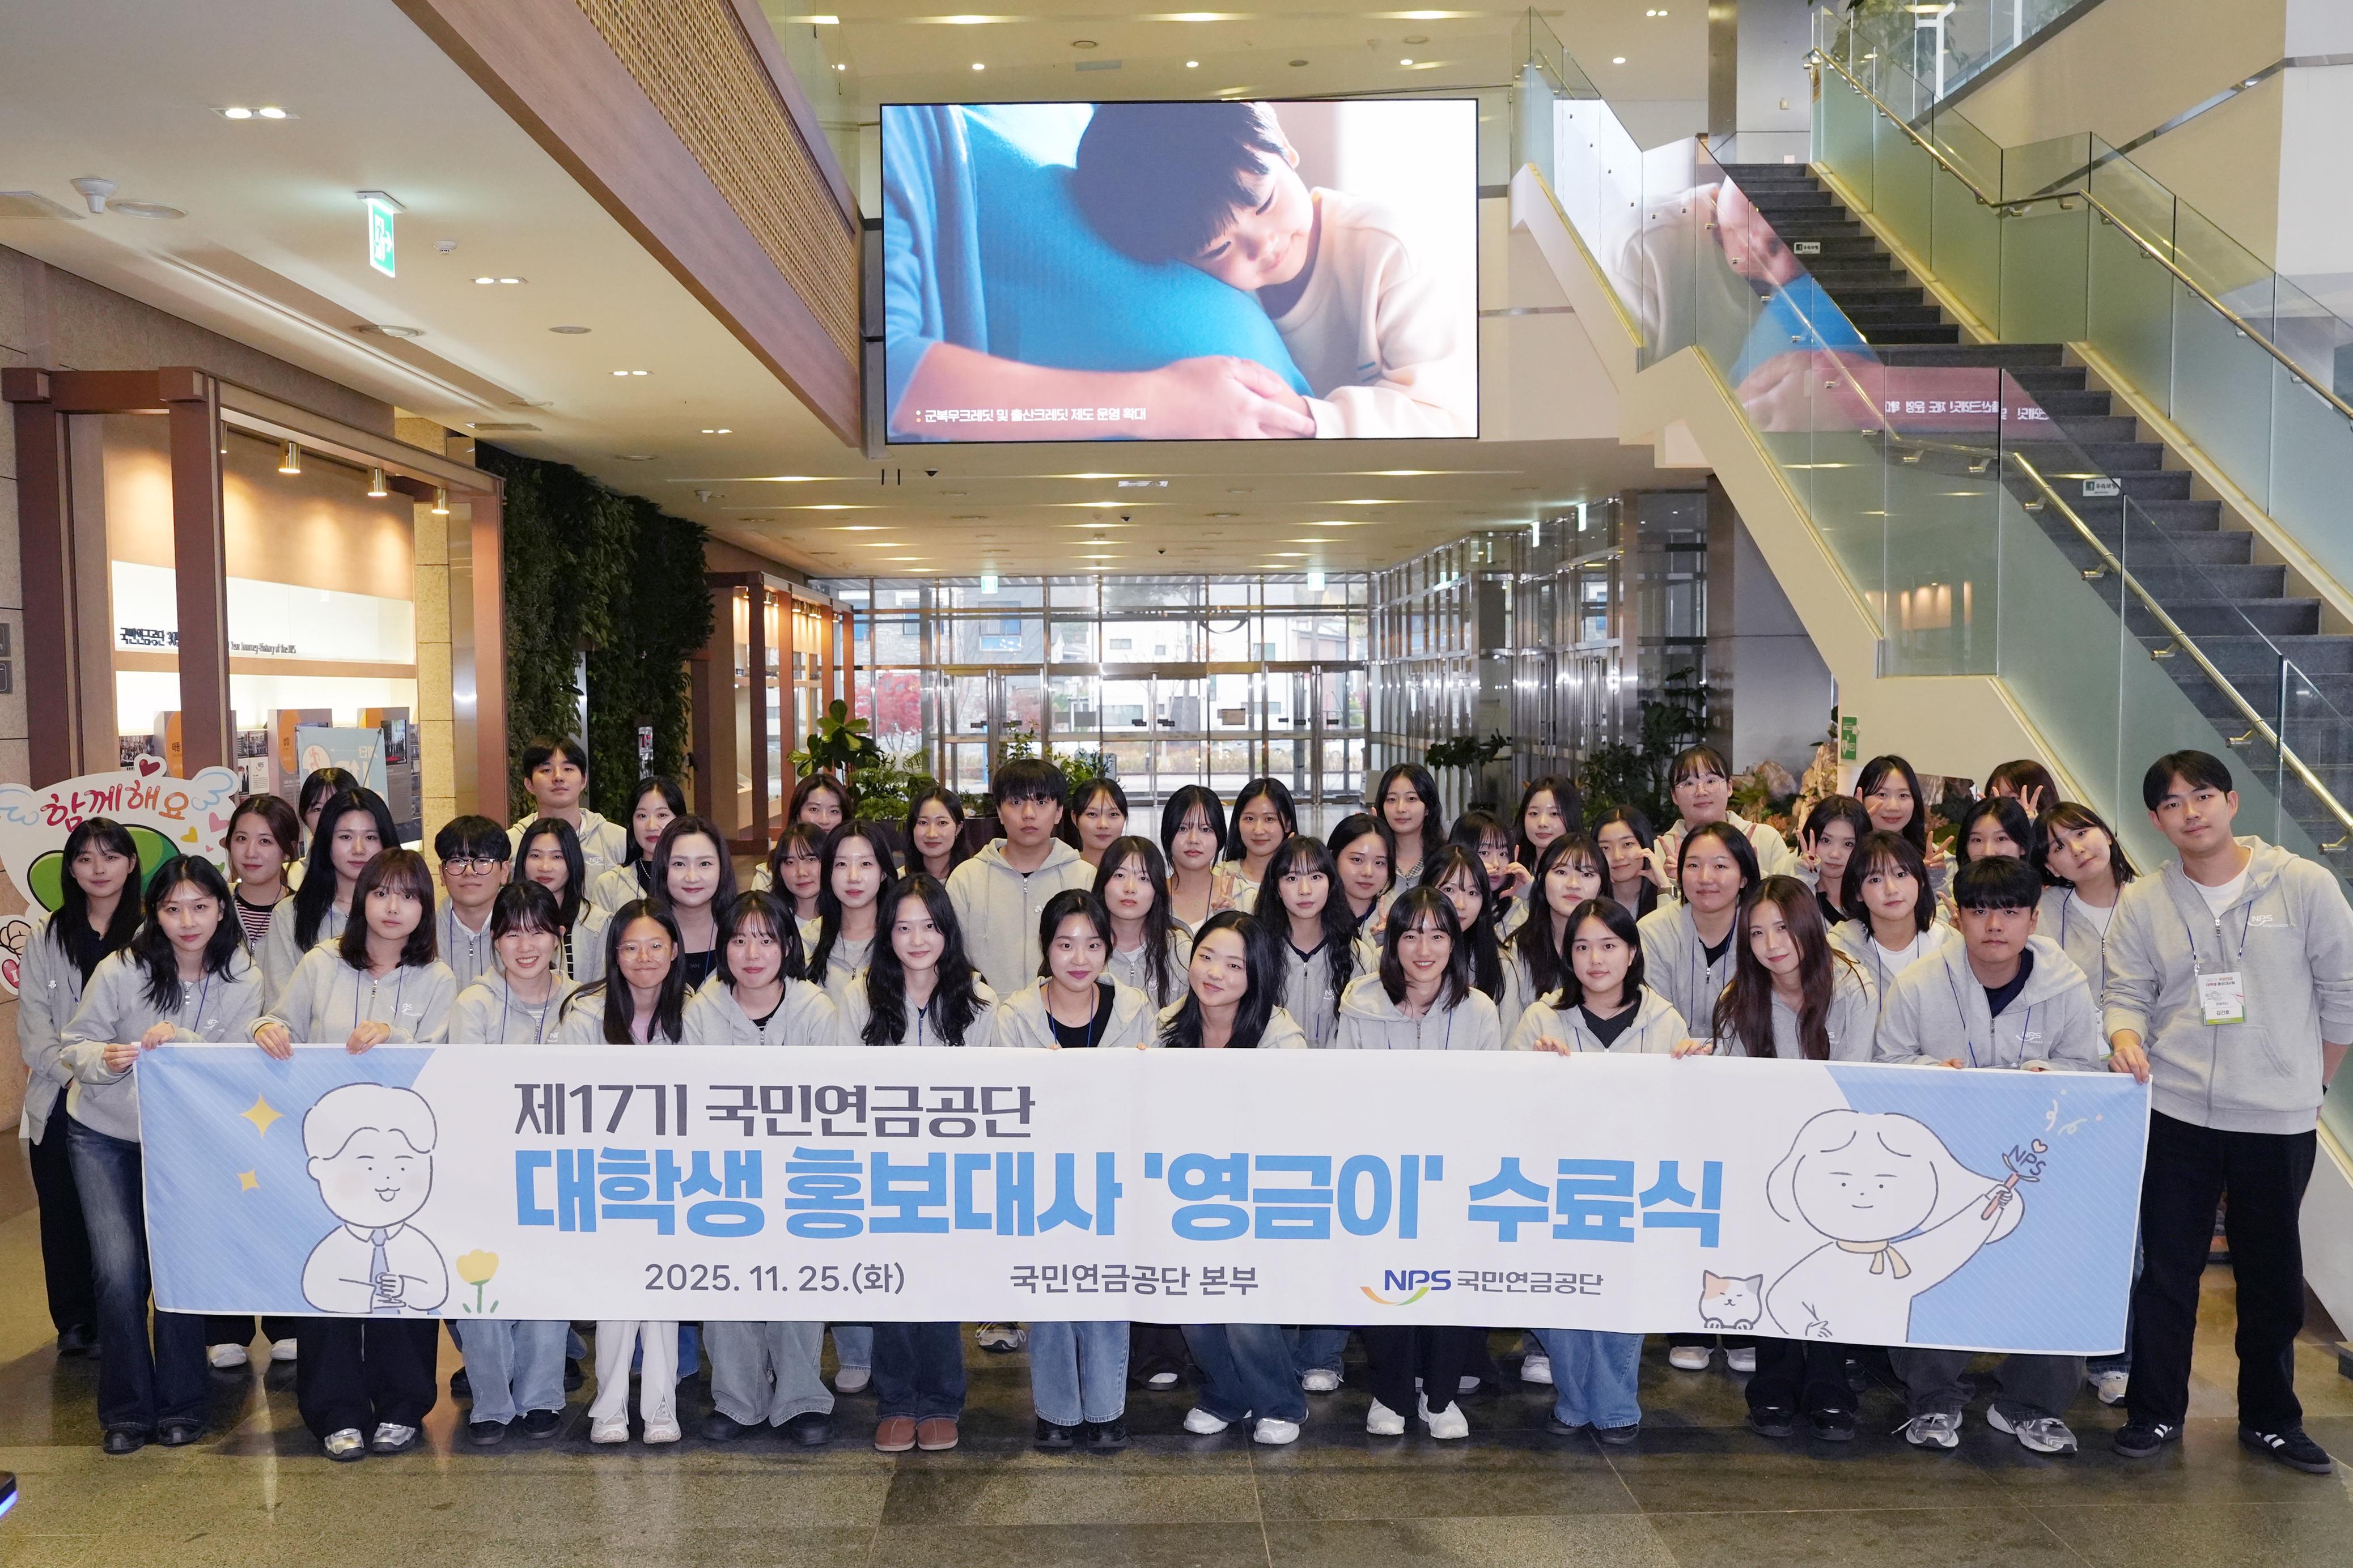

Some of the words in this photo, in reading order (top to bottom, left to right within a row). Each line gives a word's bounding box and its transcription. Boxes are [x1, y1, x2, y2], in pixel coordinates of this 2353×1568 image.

[925, 409, 994, 423] 군복무크레딧
[997, 409, 1008, 422] 및
[1011, 409, 1070, 422] 출산크레딧
[1071, 409, 1094, 421] 제도
[1097, 408, 1120, 421] 운영
[1122, 407, 1147, 421] 확대
[515, 1083, 688, 1137] 제17기
[706, 1085, 1036, 1138] 국민연금공단
[2008, 1145, 2046, 1176] NPS
[516, 1146, 765, 1238] 대학생
[785, 1146, 1123, 1239] 홍보대사
[1145, 1153, 1443, 1242] '영금이'
[1469, 1157, 1724, 1248] 수료식
[645, 1264, 740, 1292] 2025.
[749, 1266, 788, 1292] 11.
[798, 1263, 905, 1295] 25.(화)
[1010, 1264, 1192, 1297] 국민연금공단
[1199, 1266, 1260, 1297] 본부
[1384, 1269, 1452, 1291] NPS
[1457, 1270, 1604, 1296] 국민연금공단
